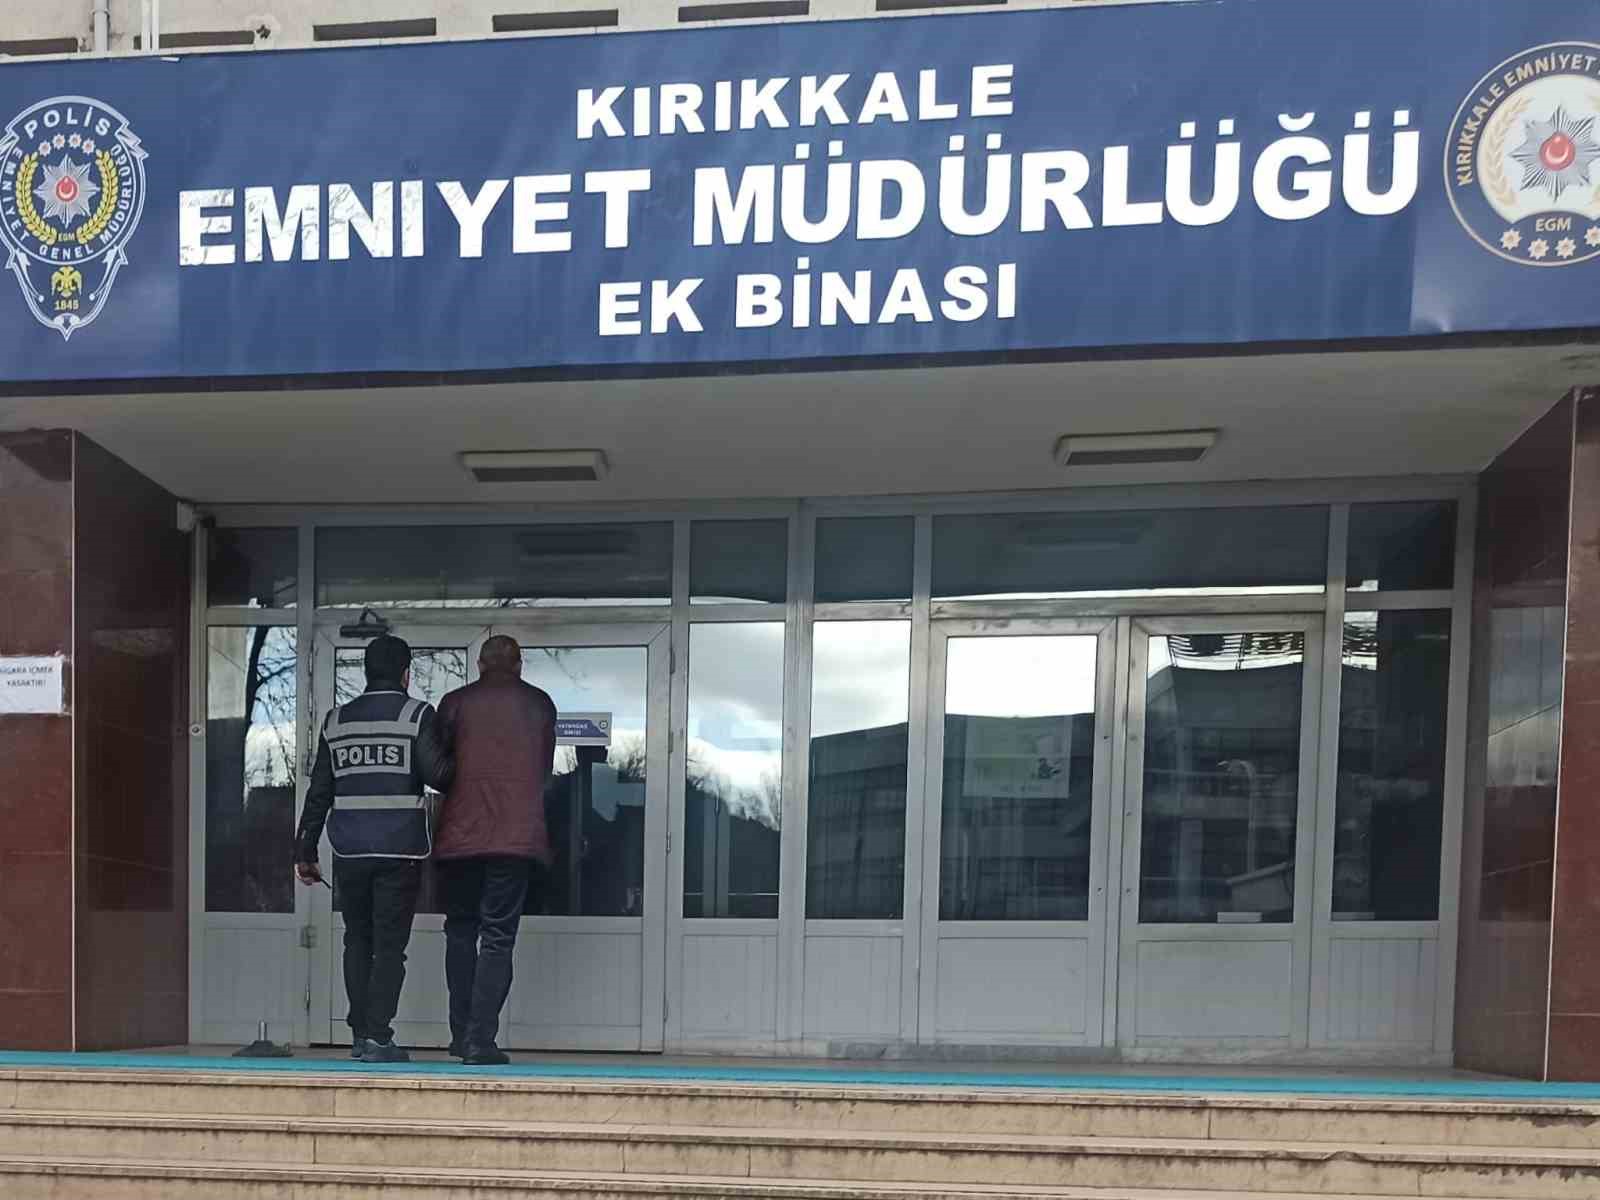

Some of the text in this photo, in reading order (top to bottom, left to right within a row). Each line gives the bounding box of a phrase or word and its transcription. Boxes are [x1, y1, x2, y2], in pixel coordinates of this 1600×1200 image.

[23, 106, 111, 140] POLİS
[576, 64, 1014, 139] KIRIKKALE
[1456, 52, 1597, 186] KIRIKKALE EMNİYET
[692, 109, 1421, 246] MÜDÜRLÜĞÜ
[39, 243, 95, 260] GENEL
[1534, 216, 1572, 232] EGM
[598, 256, 1017, 336] EK BİNASI
